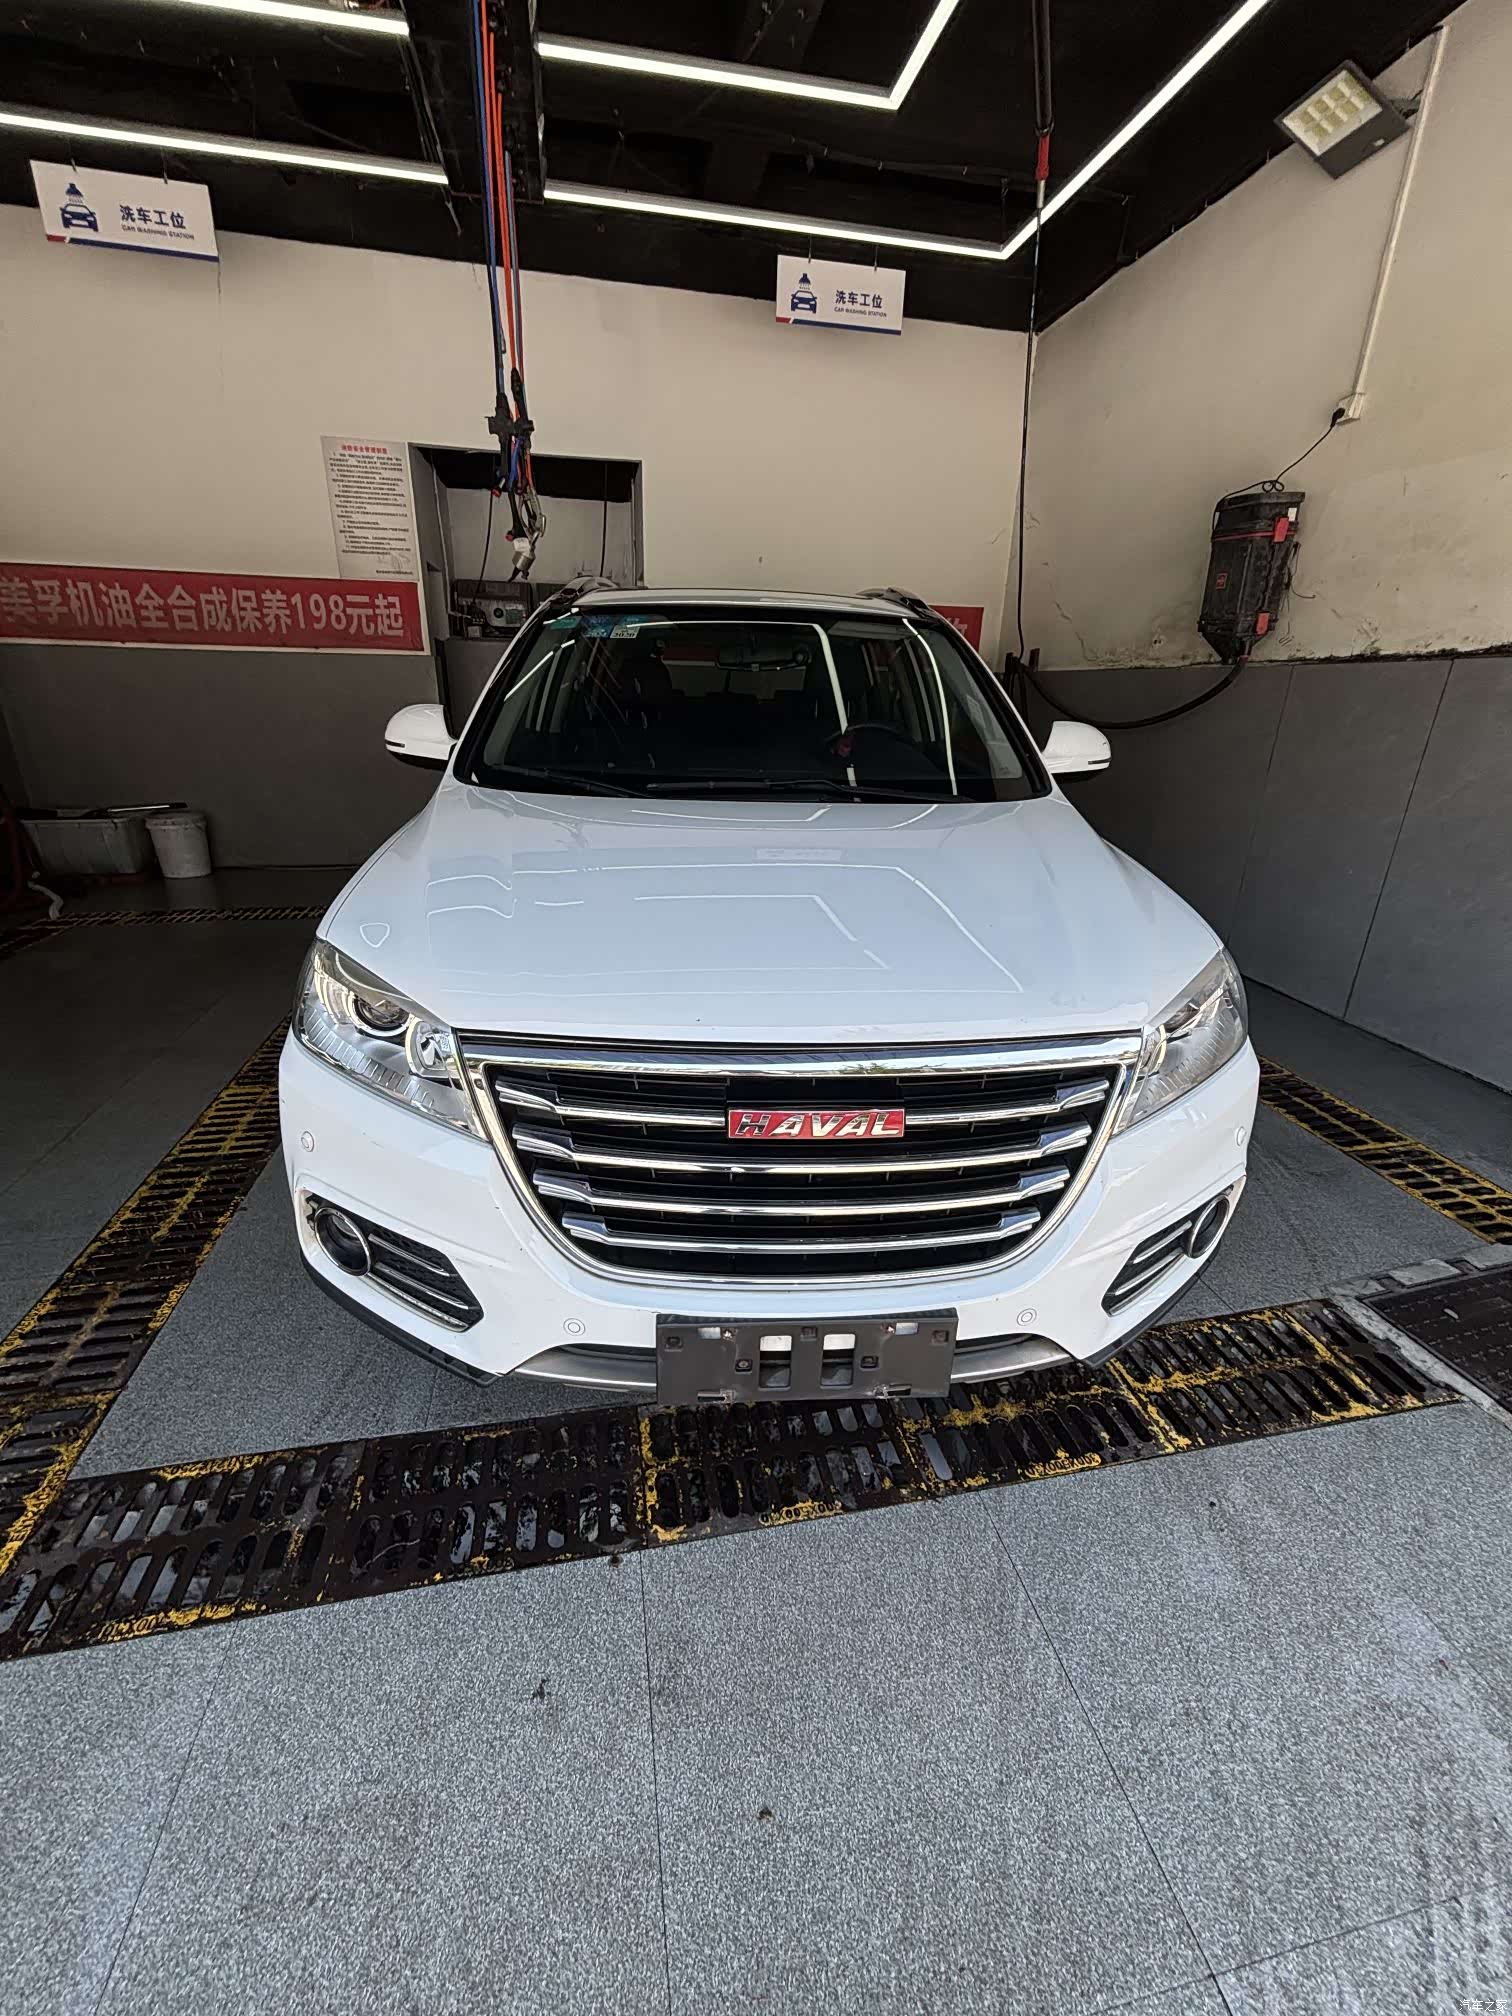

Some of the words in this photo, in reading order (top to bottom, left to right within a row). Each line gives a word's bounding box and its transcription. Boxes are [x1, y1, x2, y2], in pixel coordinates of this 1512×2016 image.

[119, 205, 186, 229] 洗车工位
[835, 290, 883, 308] 洗车工位
[0, 575, 404, 638] 美孚机油全合成保养198元起
[734, 1111, 901, 1138] HAVAL
